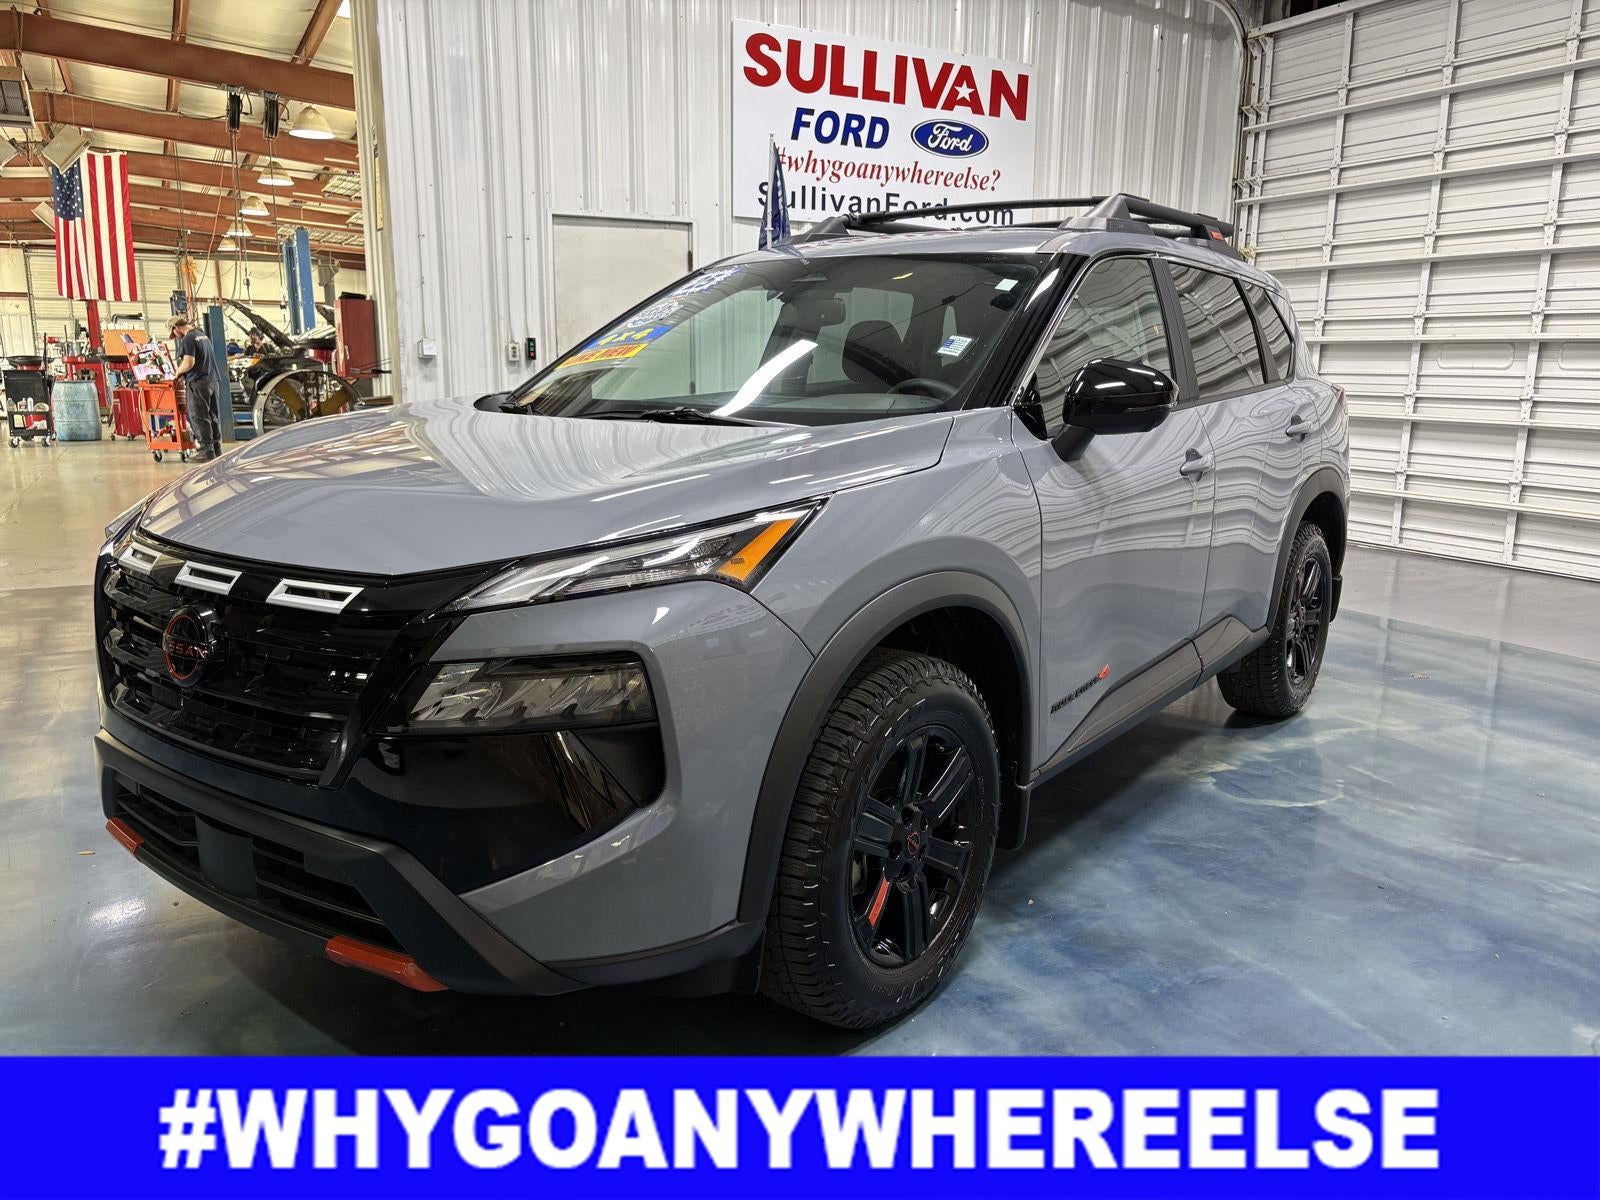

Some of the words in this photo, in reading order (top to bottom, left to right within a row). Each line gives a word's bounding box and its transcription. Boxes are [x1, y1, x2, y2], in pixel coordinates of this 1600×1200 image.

[743, 32, 1029, 121] SULLIVAN
[790, 107, 890, 150] FORD
[927, 123, 973, 153] Ford
[777, 146, 1001, 191] #whygoanywhereelse?
